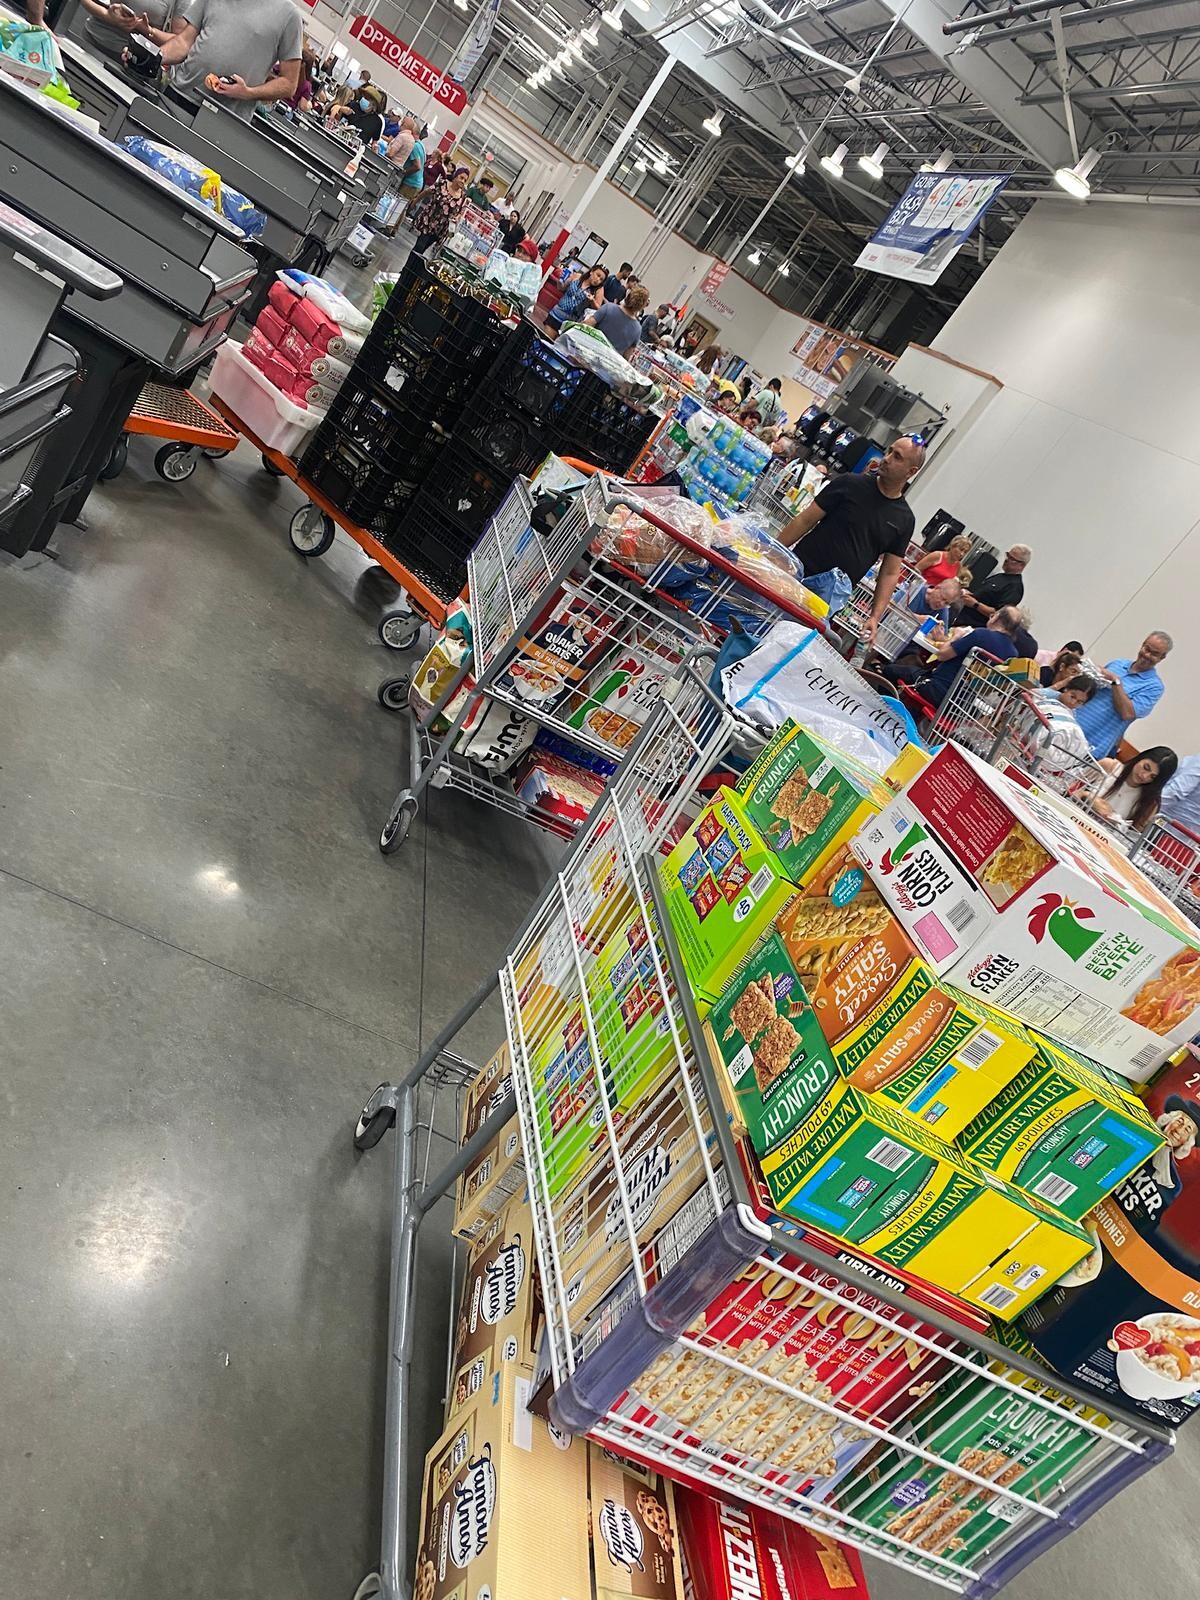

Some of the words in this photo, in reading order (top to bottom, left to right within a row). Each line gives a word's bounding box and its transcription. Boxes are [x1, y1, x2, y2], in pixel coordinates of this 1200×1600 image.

[362, 24, 461, 104] OPTOMETRIST
[545, 632, 583, 659] QUAKER
[545, 655, 571, 672] FASHONED
[548, 642, 572, 660] OATS
[805, 667, 862, 716] CEMENT
[739, 755, 766, 794] NATURE
[764, 721, 792, 755] VALLEY
[752, 739, 801, 805] CRUNCHY
[720, 802, 741, 833] VARIETY
[736, 830, 753, 853] PACK
[929, 808, 948, 828] Casserole
[944, 825, 959, 840] Brown
[955, 838, 966, 850] Hash
[963, 847, 980, 866] Crunchy
[897, 862, 937, 908] CORN
[915, 849, 954, 896] FLAKES
[738, 899, 751, 916] 40
[892, 881, 918, 912] Kellogg's
[836, 941, 865, 973] Peanut
[967, 954, 994, 981] Kellogg's
[1084, 944, 1111, 971] BEST
[1111, 932, 1125, 946] IN
[1092, 934, 1132, 976] EVERY
[1093, 941, 1106, 955] OUR
[1100, 941, 1145, 982] BITE
[835, 940, 887, 1006] SALTY
[839, 956, 897, 1026] Sweet
[856, 975, 871, 991] AND
[970, 953, 1010, 989] CORN
[980, 960, 1020, 995] FLAKES
[863, 1008, 883, 1030] BARS
[881, 971, 928, 1030] NATURE
[882, 995, 893, 1009] 48
[914, 999, 945, 1040] Sweet
[844, 1028, 885, 1073] VALLEY
[873, 1037, 909, 1074] SALTY
[928, 1014, 973, 1061] NATURE
[788, 1053, 805, 1071] Oats
[887, 1058, 931, 1101] VALLEY
[1003, 1053, 1049, 1106] NATURE
[1185, 1072, 1199, 1088] 2
[761, 1059, 830, 1148] CRUNCHY
[762, 1078, 783, 1103] Honey
[819, 1099, 833, 1117] 49
[779, 1115, 823, 1162] POUCHES
[810, 1095, 859, 1153] NATURE
[960, 1098, 1004, 1147] VALLEY
[975, 1113, 1028, 1167] NATURE
[1018, 1074, 1073, 1122] VALLEY
[1014, 1138, 1027, 1154] 49
[1024, 1106, 1064, 1143] POUCHES
[1039, 1124, 1071, 1154] CRUNCHY
[772, 1149, 811, 1197] VALLEY
[880, 1188, 910, 1219] CRUNCHY
[922, 1190, 936, 1202] 49
[925, 1176, 974, 1231] NATURE
[1114, 1178, 1140, 1212] TS
[1132, 1170, 1163, 1220] KER
[888, 1201, 928, 1237] POUCHES
[1093, 1203, 1127, 1248] SHIONED
[881, 1227, 927, 1266] VALLEY
[485, 1261, 504, 1319] Amos
[498, 1233, 523, 1315] Famous
[809, 1268, 896, 1318] MICROWAVE
[838, 1253, 905, 1293] KIRKLAND
[735, 1260, 927, 1371] POPCORN
[754, 1299, 791, 1322] MOVE
[791, 1316, 836, 1346] TEATER
[507, 1342, 517, 1360] 42
[732, 1311, 747, 1324] MAD
[765, 1328, 785, 1341] HOL
[787, 1337, 804, 1350] RAIN
[804, 1346, 831, 1362] OPCOR
[860, 1373, 875, 1385] REE
[816, 1341, 837, 1357] othr
[836, 1350, 861, 1368] Naural
[988, 1392, 1082, 1452] CRUNCHY
[1009, 1447, 1036, 1467] Hney
[467, 1441, 492, 1557] Famous
[453, 1480, 474, 1562] Amos
[604, 1498, 632, 1574] Famous
[622, 1508, 646, 1573] Amos
